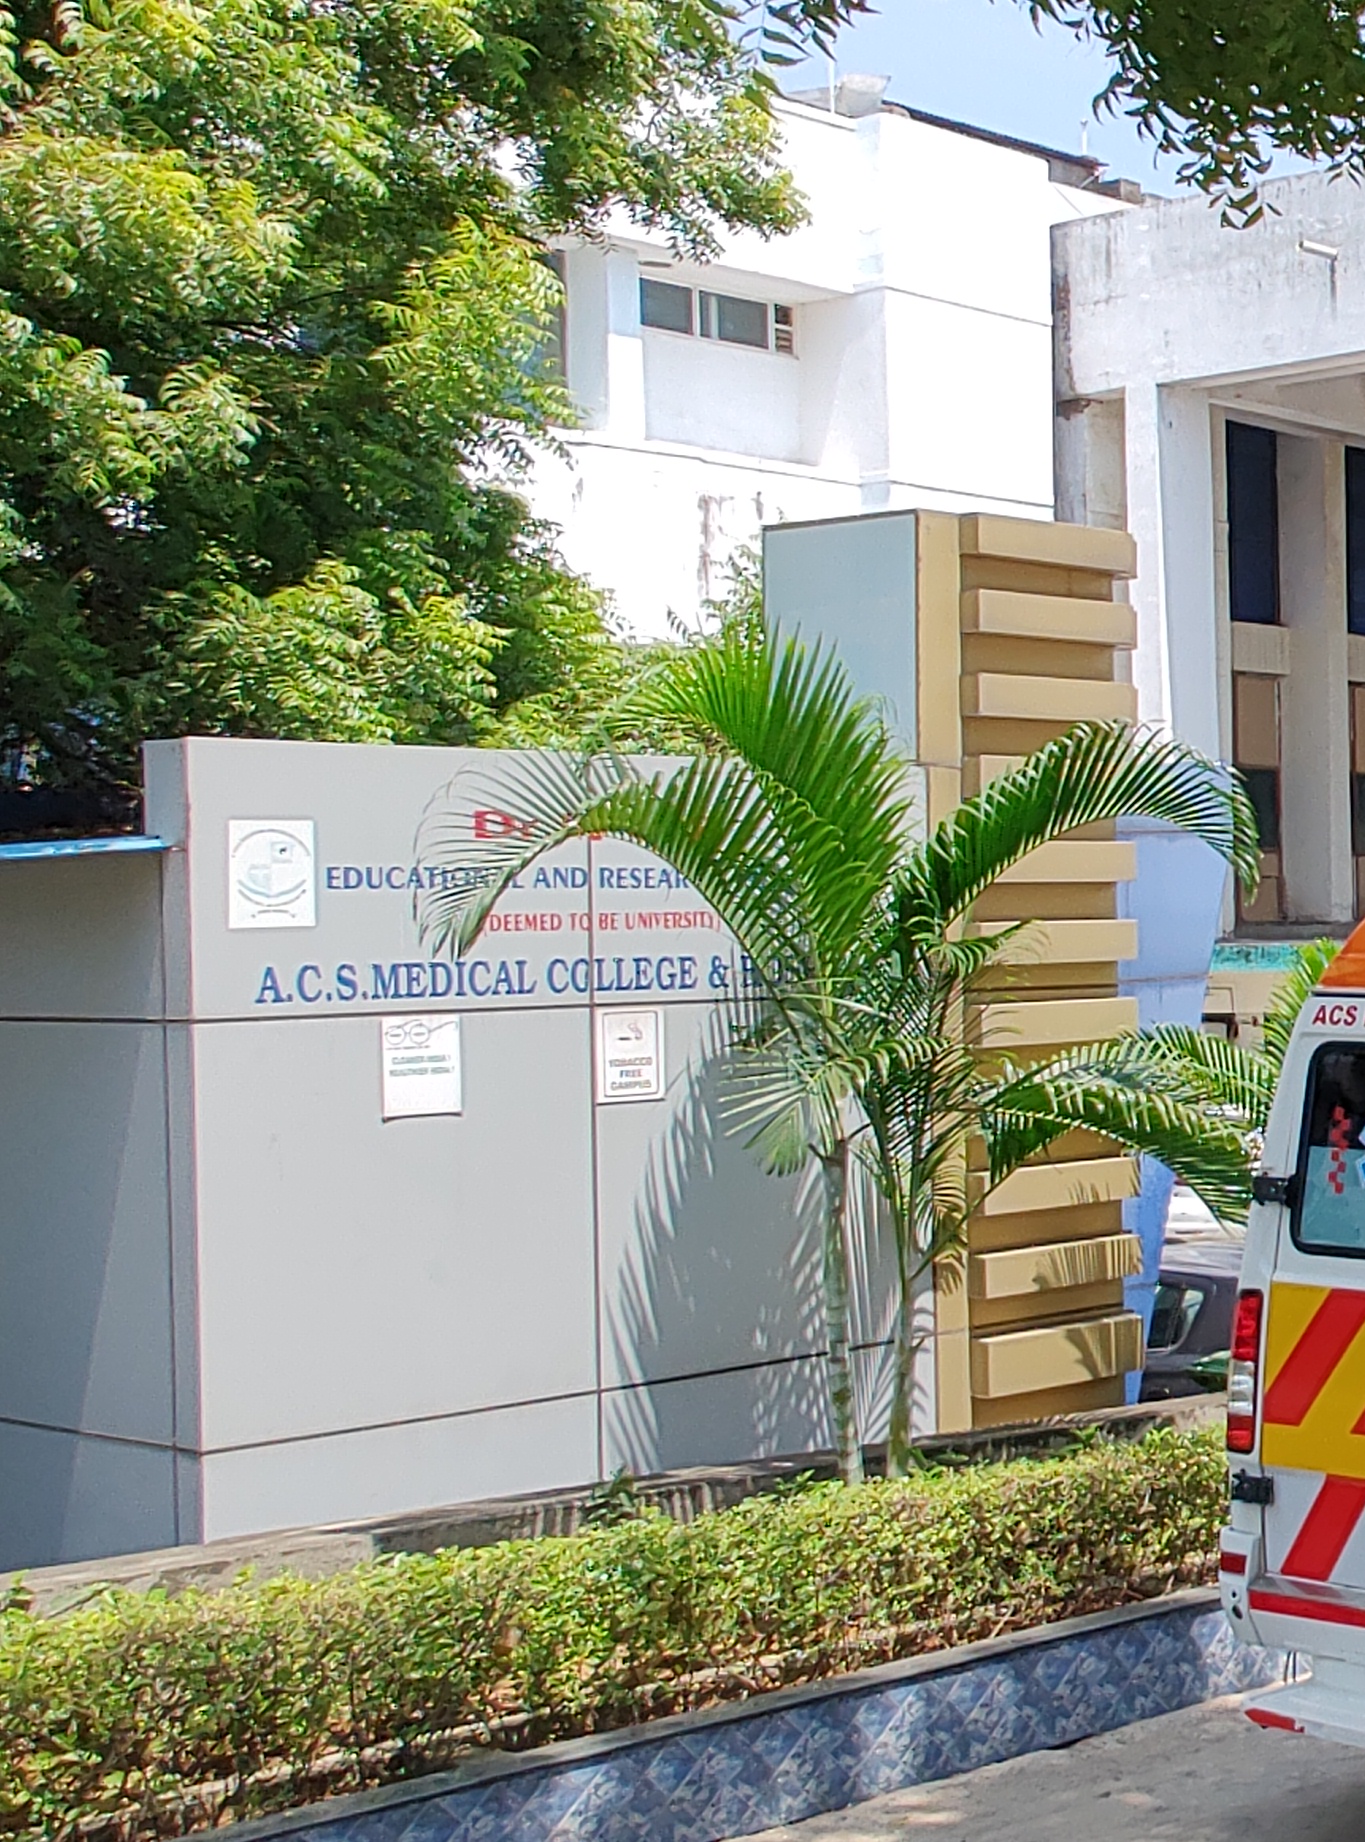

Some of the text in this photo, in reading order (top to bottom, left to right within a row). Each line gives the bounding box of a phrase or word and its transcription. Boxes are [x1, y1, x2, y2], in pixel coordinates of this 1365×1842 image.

[532, 867, 587, 888] AND
[570, 913, 591, 932] TO
[599, 912, 618, 931] BE
[625, 911, 721, 932] UNIVERSITY)
[546, 955, 698, 993] COLLEGE
[708, 955, 731, 989] &
[1313, 1005, 1358, 1027] ACS
[620, 1068, 643, 1078] FREE
